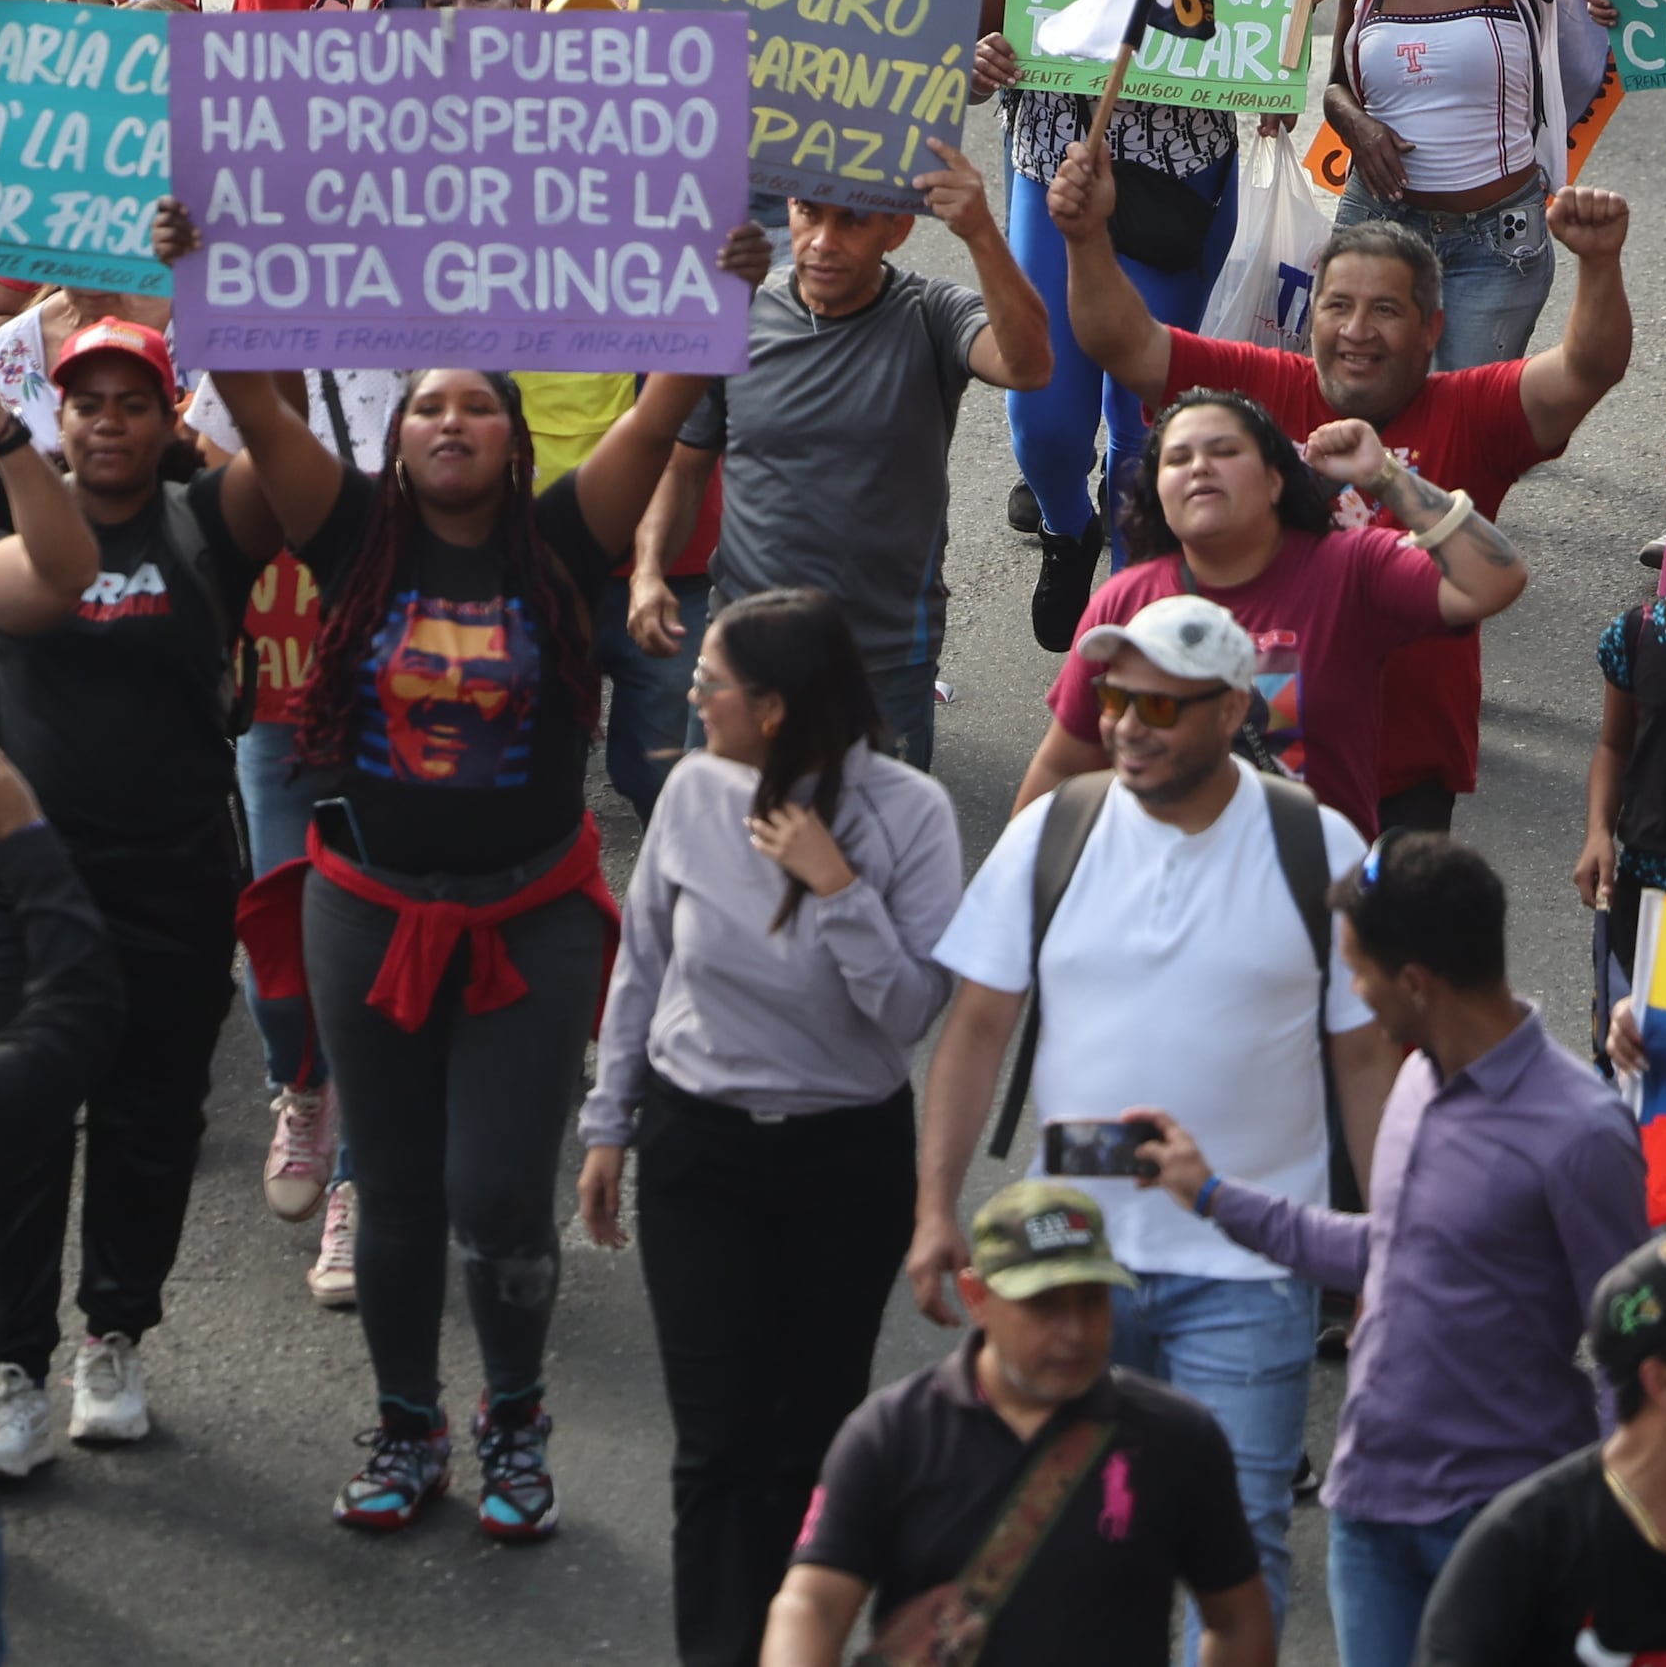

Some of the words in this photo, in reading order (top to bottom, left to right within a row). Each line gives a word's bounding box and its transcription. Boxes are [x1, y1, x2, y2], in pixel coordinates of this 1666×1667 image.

[201, 13, 445, 88] NINGÚN
[469, 24, 714, 88] PUEBLO
[1397, 42, 1426, 73] T
[200, 95, 285, 154] HA
[307, 95, 720, 160] PROSPERADO
[1190, 89, 1211, 104] DE
[31, 107, 89, 172] LA
[747, 105, 922, 188] PAZ!
[205, 166, 285, 229] AL
[305, 166, 512, 230] CALOR
[532, 166, 612, 227] DE
[634, 170, 713, 232] LA
[28, 255, 134, 287] FRANCISCO
[137, 268, 164, 291] DE
[204, 242, 403, 311] BOTA
[422, 242, 721, 318] GRINGA
[203, 325, 325, 355] FRENTE
[333, 327, 499, 355] FRANCISCO
[509, 331, 555, 355] DE
[563, 330, 711, 358] MIRANDA
